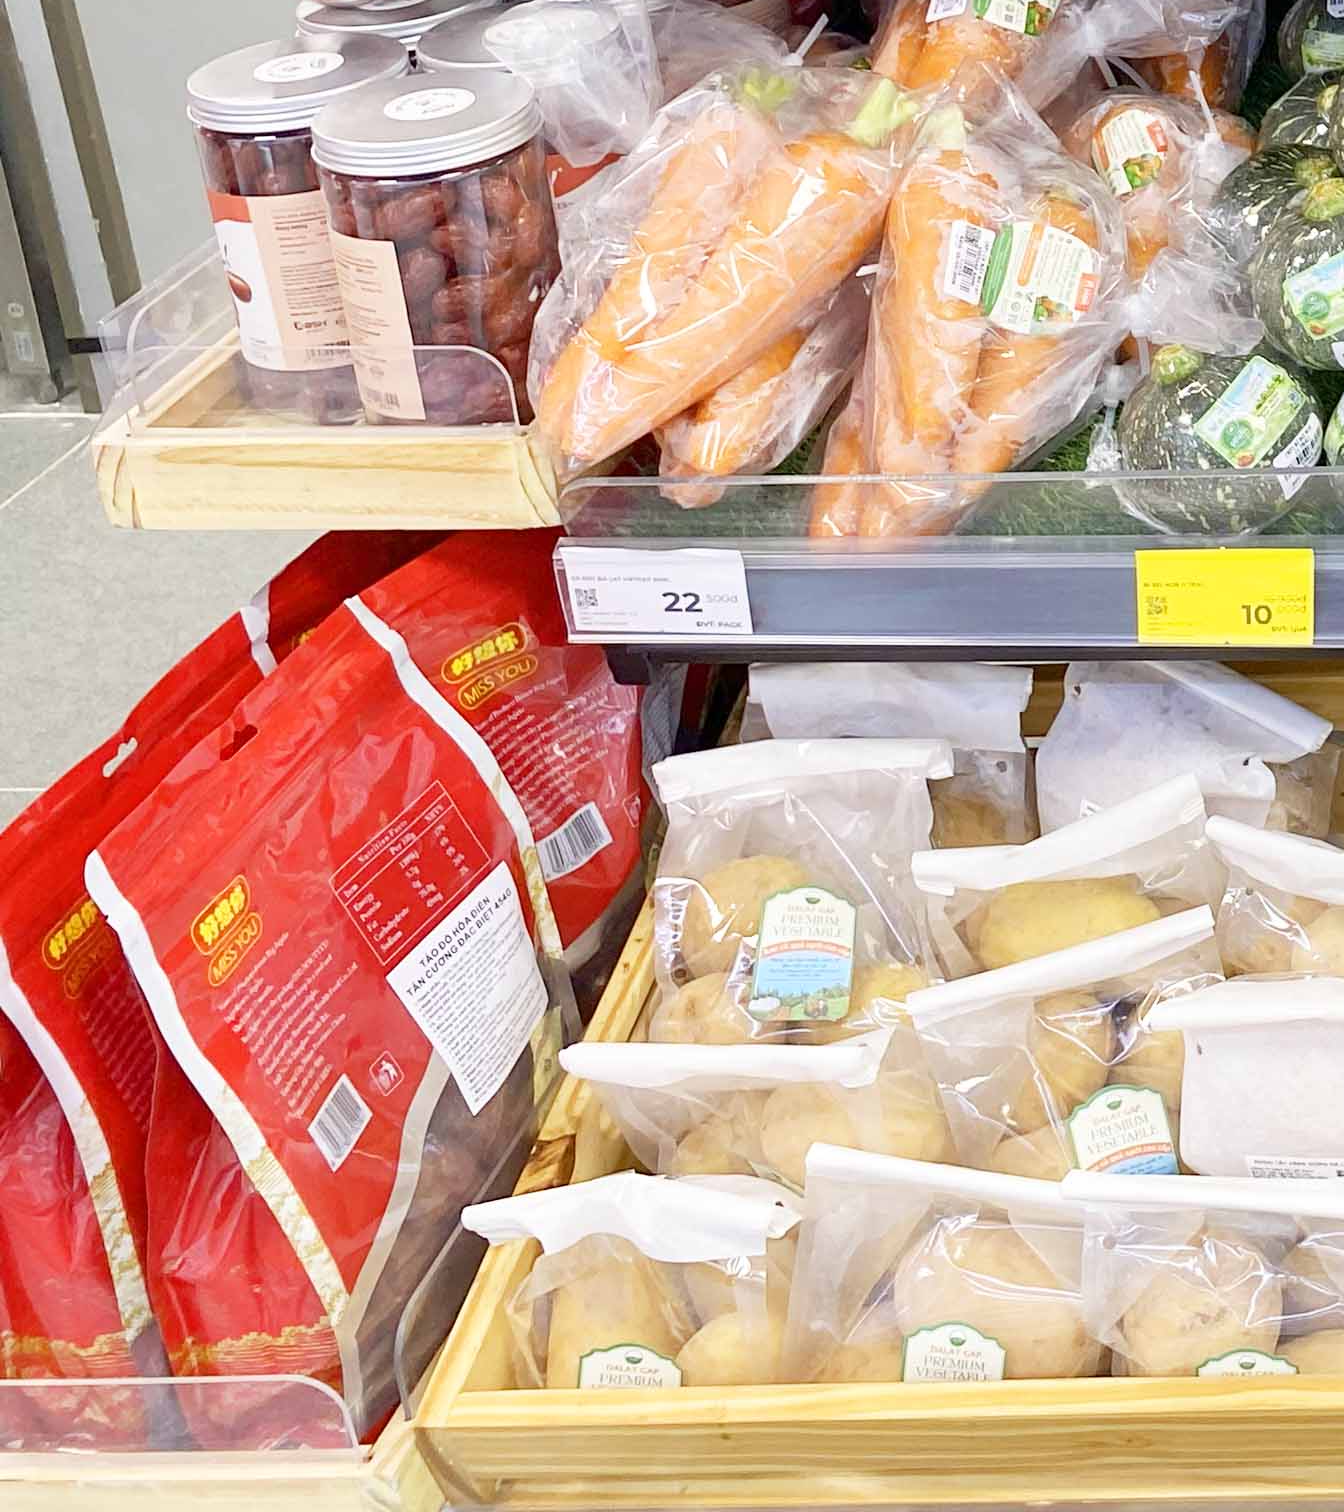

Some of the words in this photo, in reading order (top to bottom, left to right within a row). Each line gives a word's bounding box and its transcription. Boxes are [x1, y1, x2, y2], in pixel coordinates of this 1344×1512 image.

[663, 593, 702, 612] 22
[1241, 603, 1272, 625] 10
[463, 674, 496, 705] MISS
[498, 659, 531, 683] YOU
[212, 946, 237, 981] MISS
[237, 918, 259, 956] YOU
